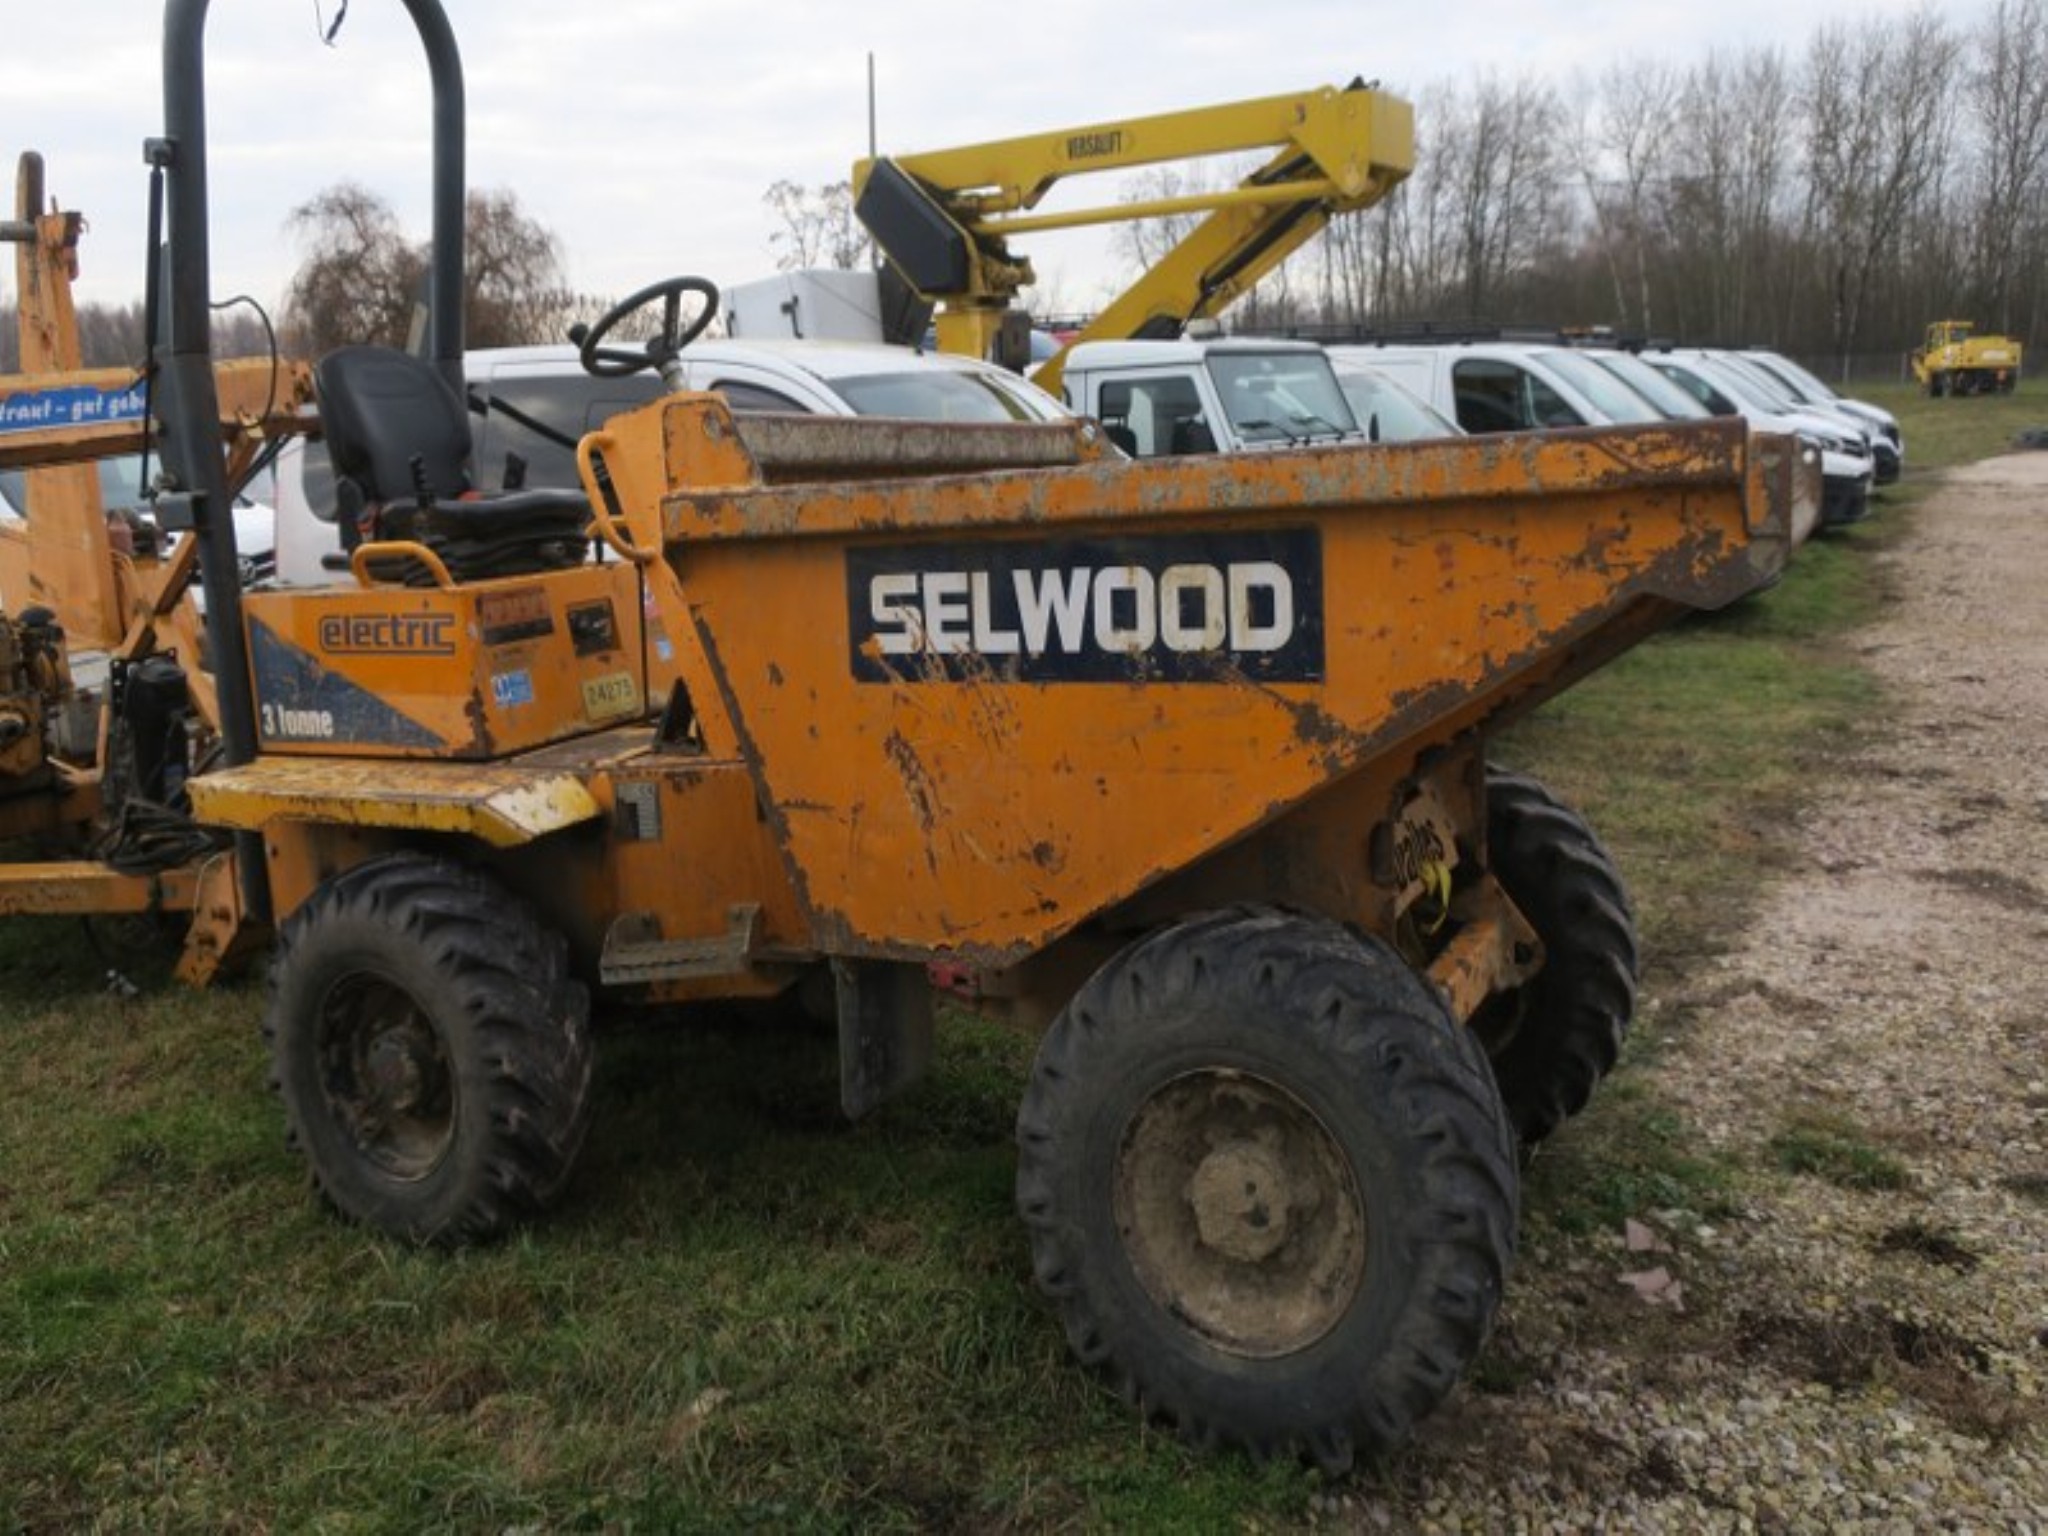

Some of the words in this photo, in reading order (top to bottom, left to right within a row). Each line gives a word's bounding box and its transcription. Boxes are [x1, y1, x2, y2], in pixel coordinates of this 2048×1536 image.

[72, 393, 103, 421] gut
[869, 561, 1294, 655] SELWOOD
[321, 613, 455, 650] electric
[261, 703, 275, 736] 3
[278, 703, 334, 738] tonne
